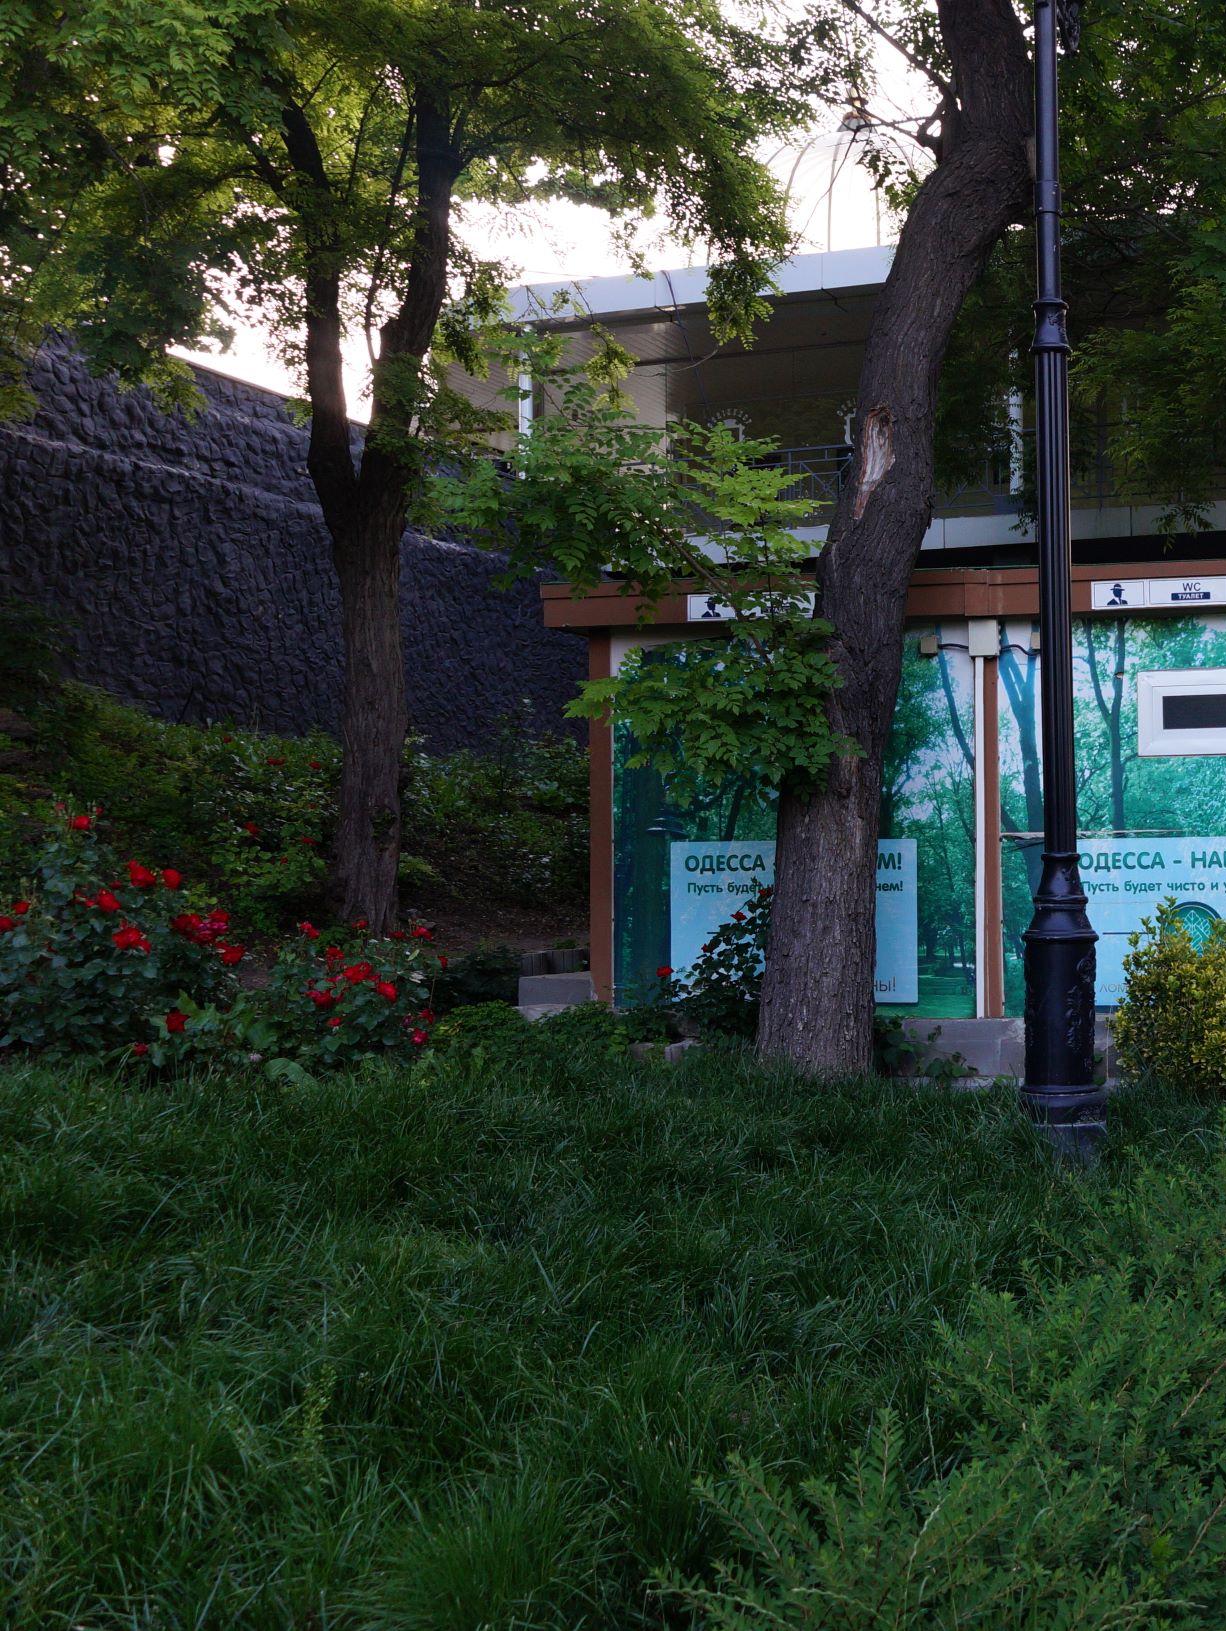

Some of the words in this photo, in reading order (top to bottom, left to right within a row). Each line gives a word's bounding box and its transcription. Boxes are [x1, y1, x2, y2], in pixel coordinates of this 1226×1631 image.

[1182, 582, 1201, 592] WC
[684, 854, 766, 874] ОДЕССА
[1078, 851, 1165, 872] ОДЕССА
[688, 882, 723, 895] Пусть
[1082, 880, 1119, 894] Пусть
[1124, 879, 1161, 894] будет
[1167, 881, 1205, 891] чисто
[1210, 882, 1219, 890] и
